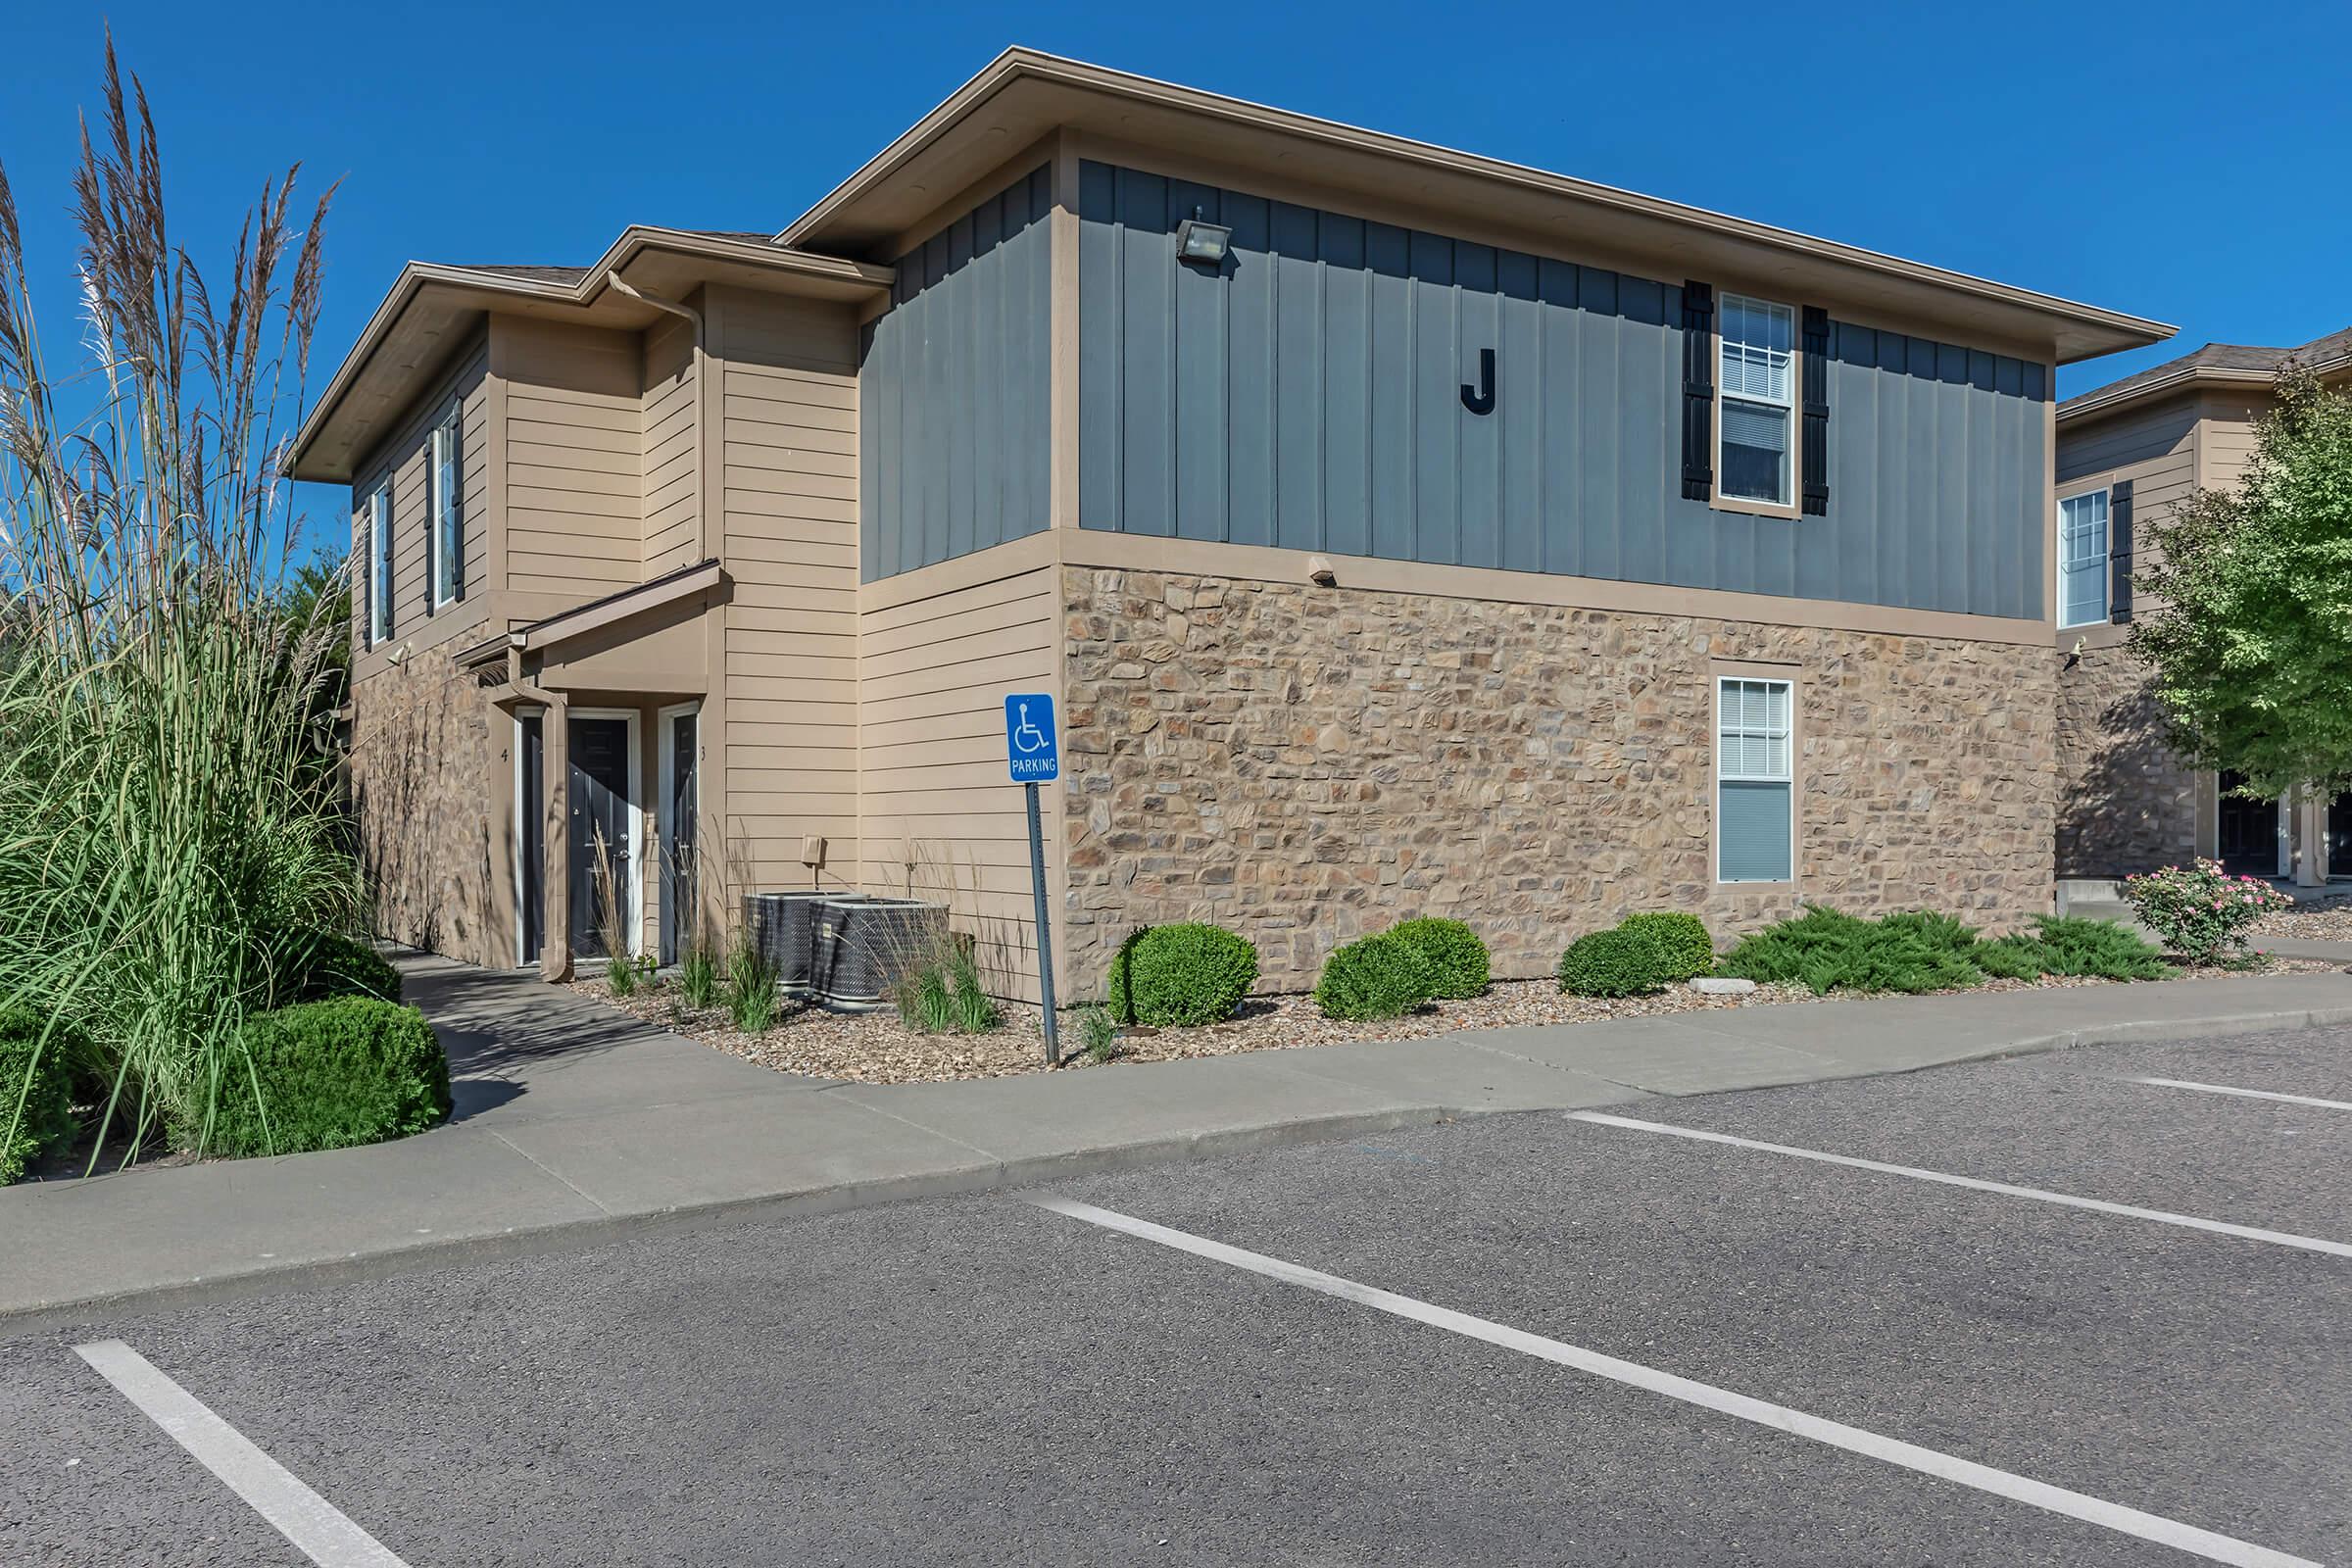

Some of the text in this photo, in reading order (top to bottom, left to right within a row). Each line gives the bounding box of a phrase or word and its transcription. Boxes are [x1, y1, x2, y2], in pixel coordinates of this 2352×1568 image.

[1460, 348, 1495, 416] J
[501, 749, 509, 762] 4
[1012, 758, 1056, 773] PARKING
